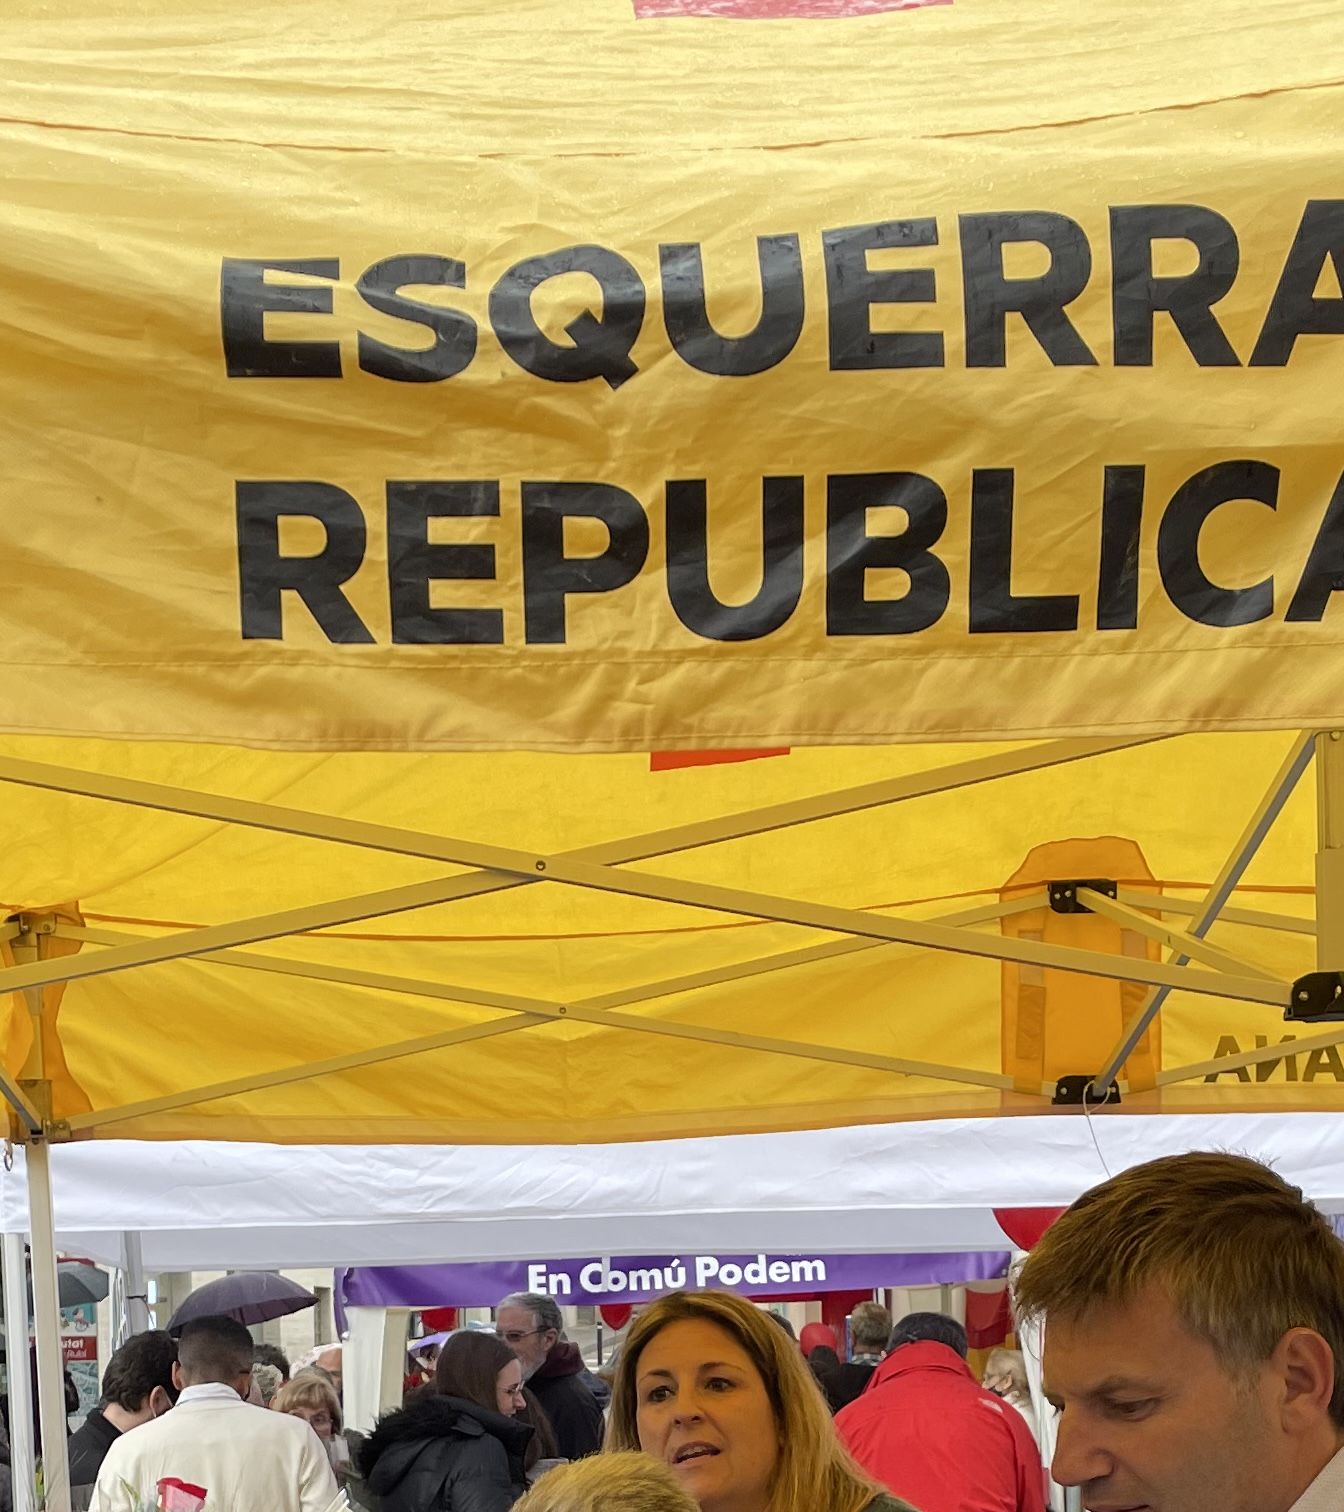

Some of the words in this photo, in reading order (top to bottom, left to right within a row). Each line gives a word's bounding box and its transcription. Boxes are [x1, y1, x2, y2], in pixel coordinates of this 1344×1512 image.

[527, 1264, 572, 1295] En
[579, 1258, 687, 1293] Comú
[695, 1253, 827, 1288] Podem
